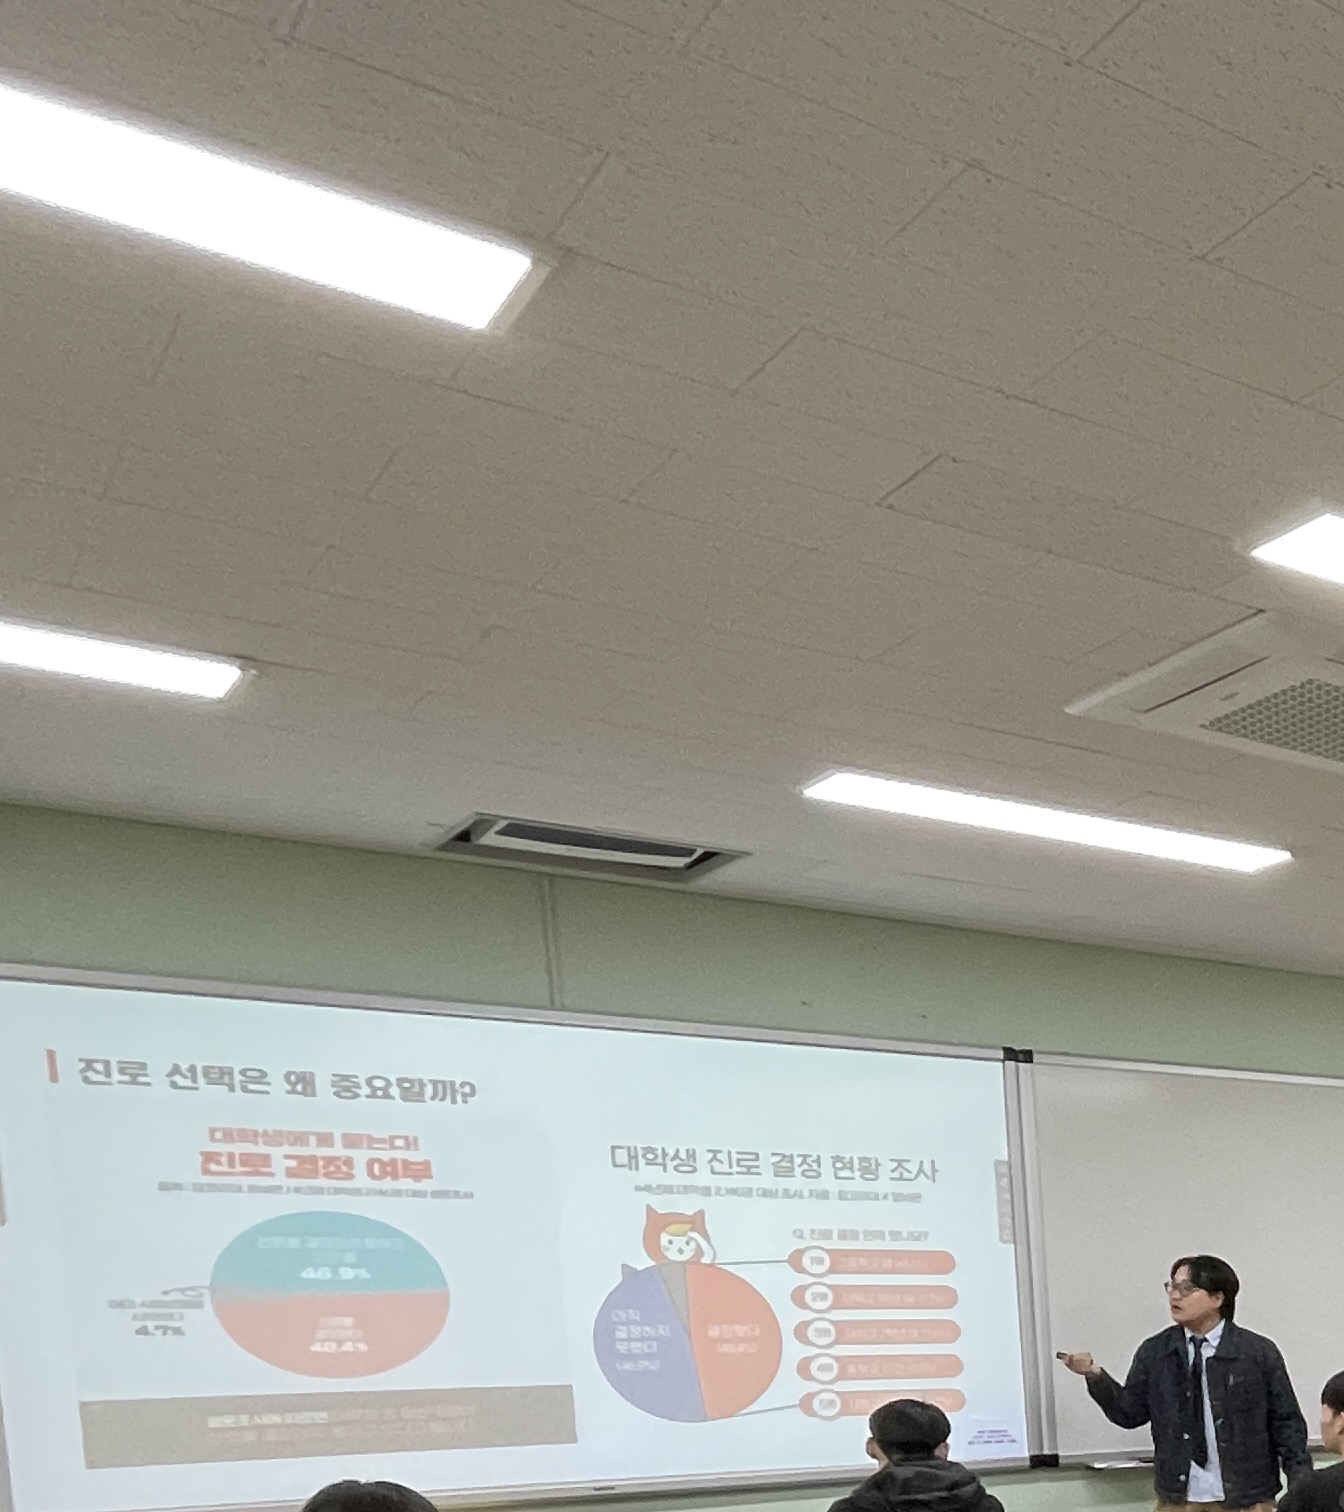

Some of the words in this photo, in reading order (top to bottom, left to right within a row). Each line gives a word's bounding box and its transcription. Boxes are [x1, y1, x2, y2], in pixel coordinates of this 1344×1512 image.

[78, 1057, 152, 1087] 진로
[165, 1062, 271, 1095] 선택은
[283, 1070, 318, 1098] 왜
[330, 1072, 478, 1106] 중요할까?
[199, 1150, 276, 1178] 진로
[282, 1154, 356, 1181] 결정
[366, 1157, 434, 1183] 여부
[610, 1144, 698, 1174] 대학생
[706, 1148, 763, 1176] 진로
[770, 1152, 822, 1180] 결정
[830, 1154, 882, 1182] 현황
[888, 1157, 939, 1183] 조사
